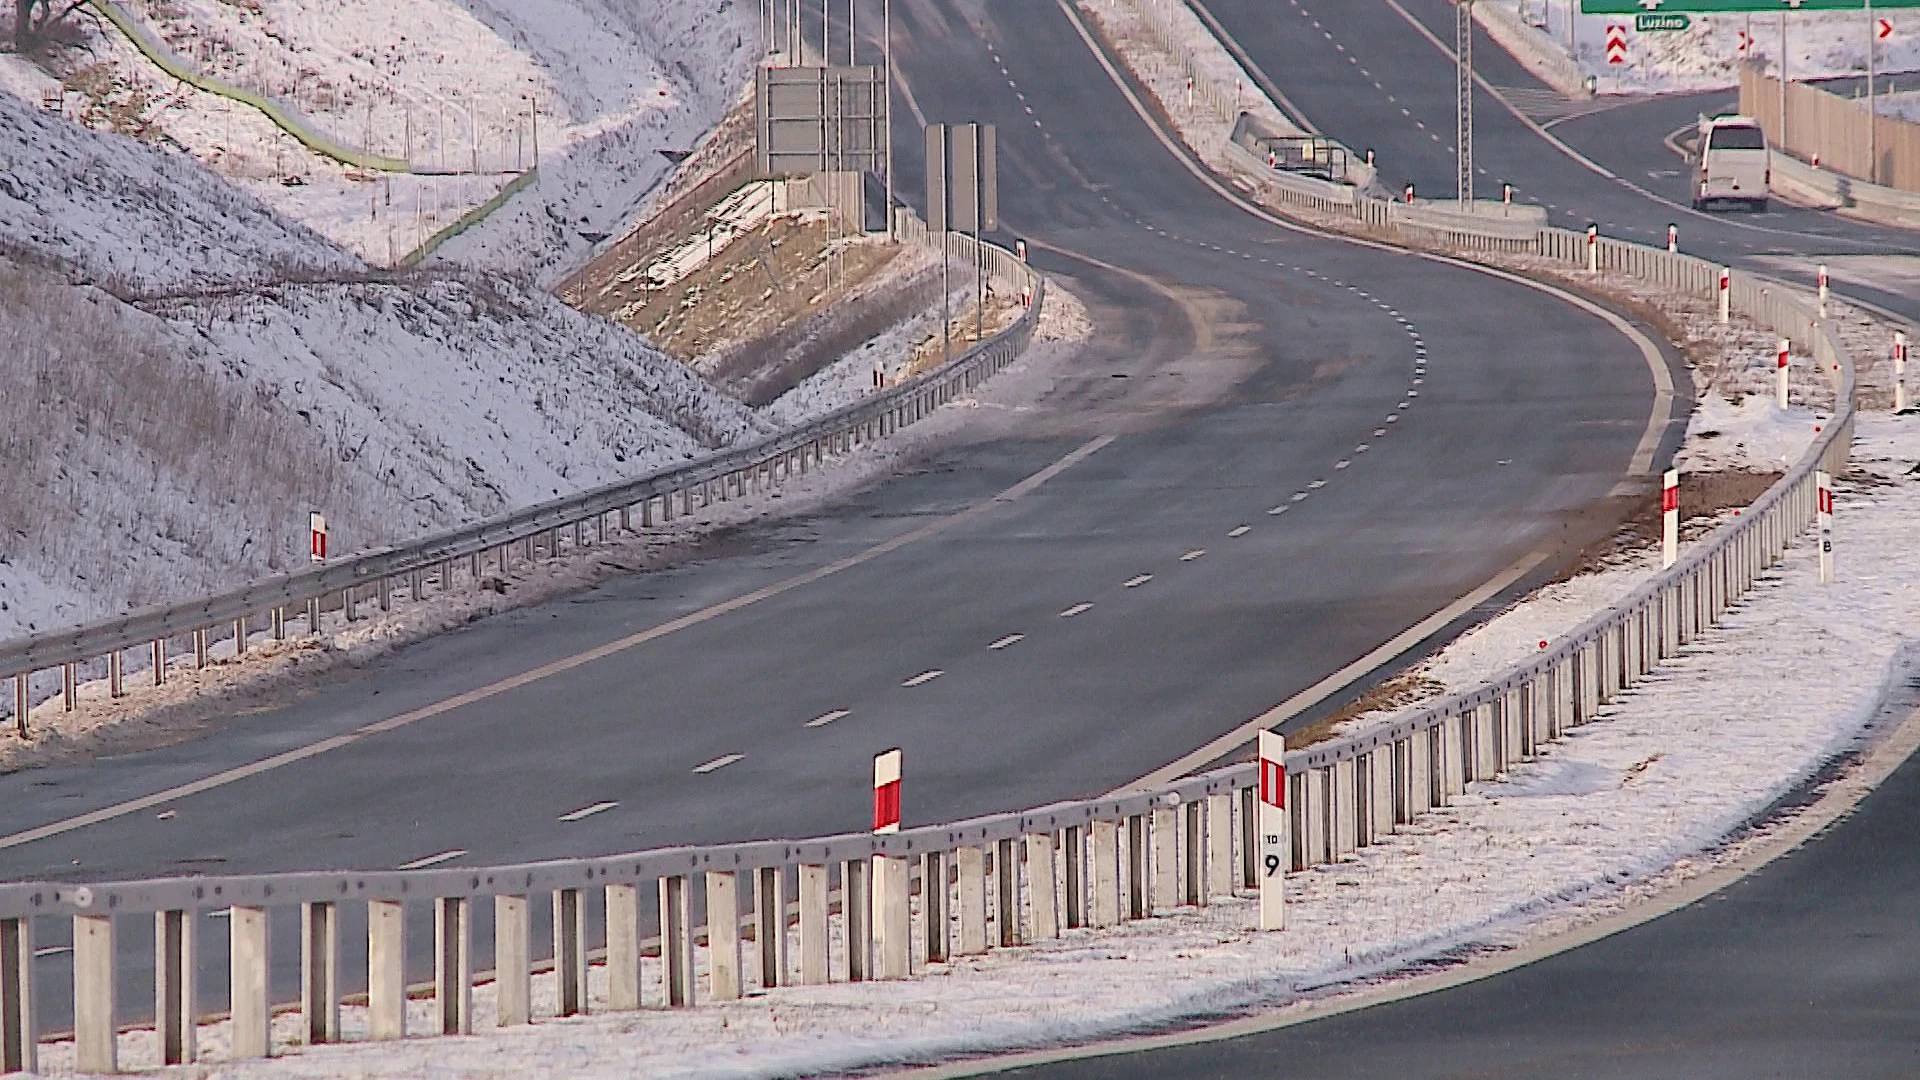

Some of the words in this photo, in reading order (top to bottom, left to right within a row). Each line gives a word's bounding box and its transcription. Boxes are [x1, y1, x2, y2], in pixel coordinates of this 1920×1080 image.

[1639, 15, 1684, 28] Luzino
[1266, 835, 1278, 844] 10
[1265, 854, 1279, 877] 9
